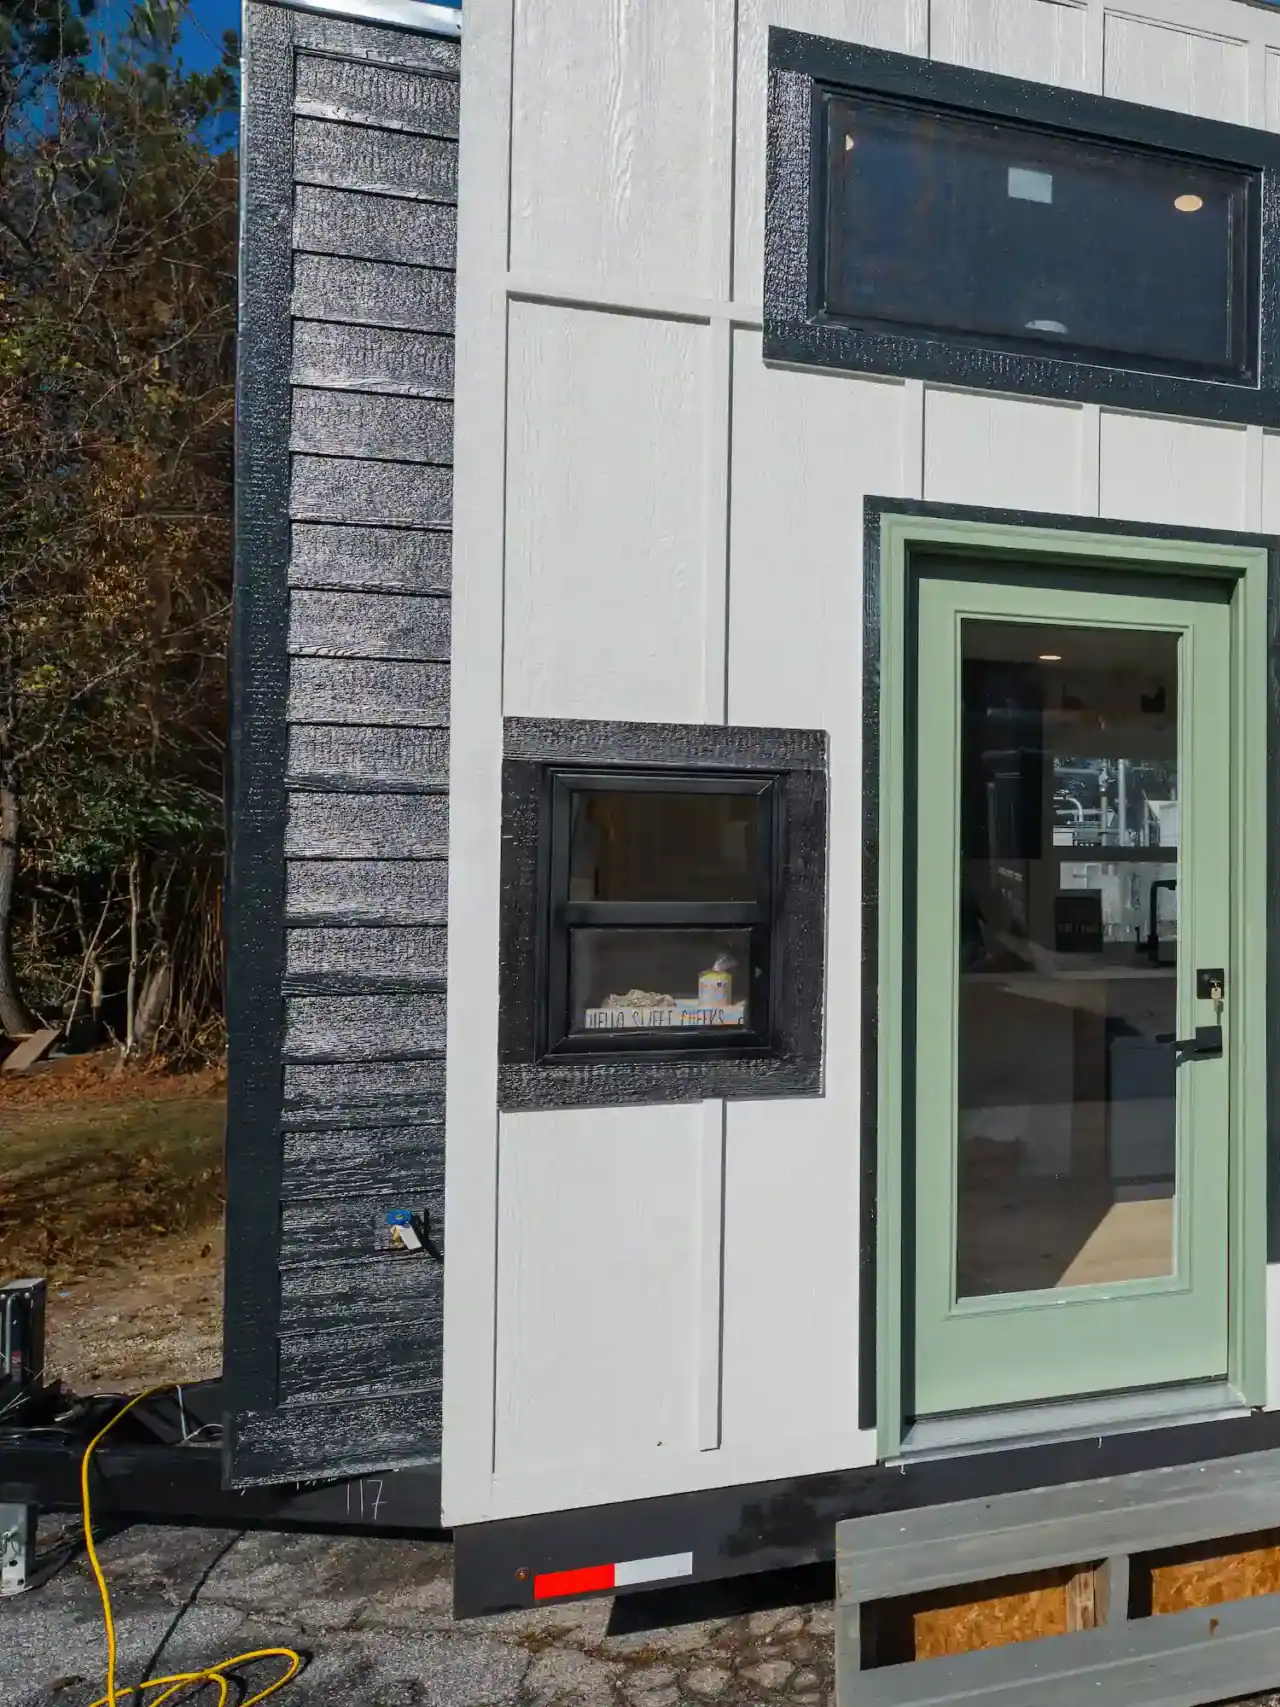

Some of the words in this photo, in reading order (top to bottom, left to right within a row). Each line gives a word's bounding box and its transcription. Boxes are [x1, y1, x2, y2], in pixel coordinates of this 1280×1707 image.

[588, 1011, 625, 1029] HELLO
[632, 1010, 673, 1028] SWEET
[681, 1009, 724, 1026] CHEEKS
[346, 1478, 387, 1520] 117
